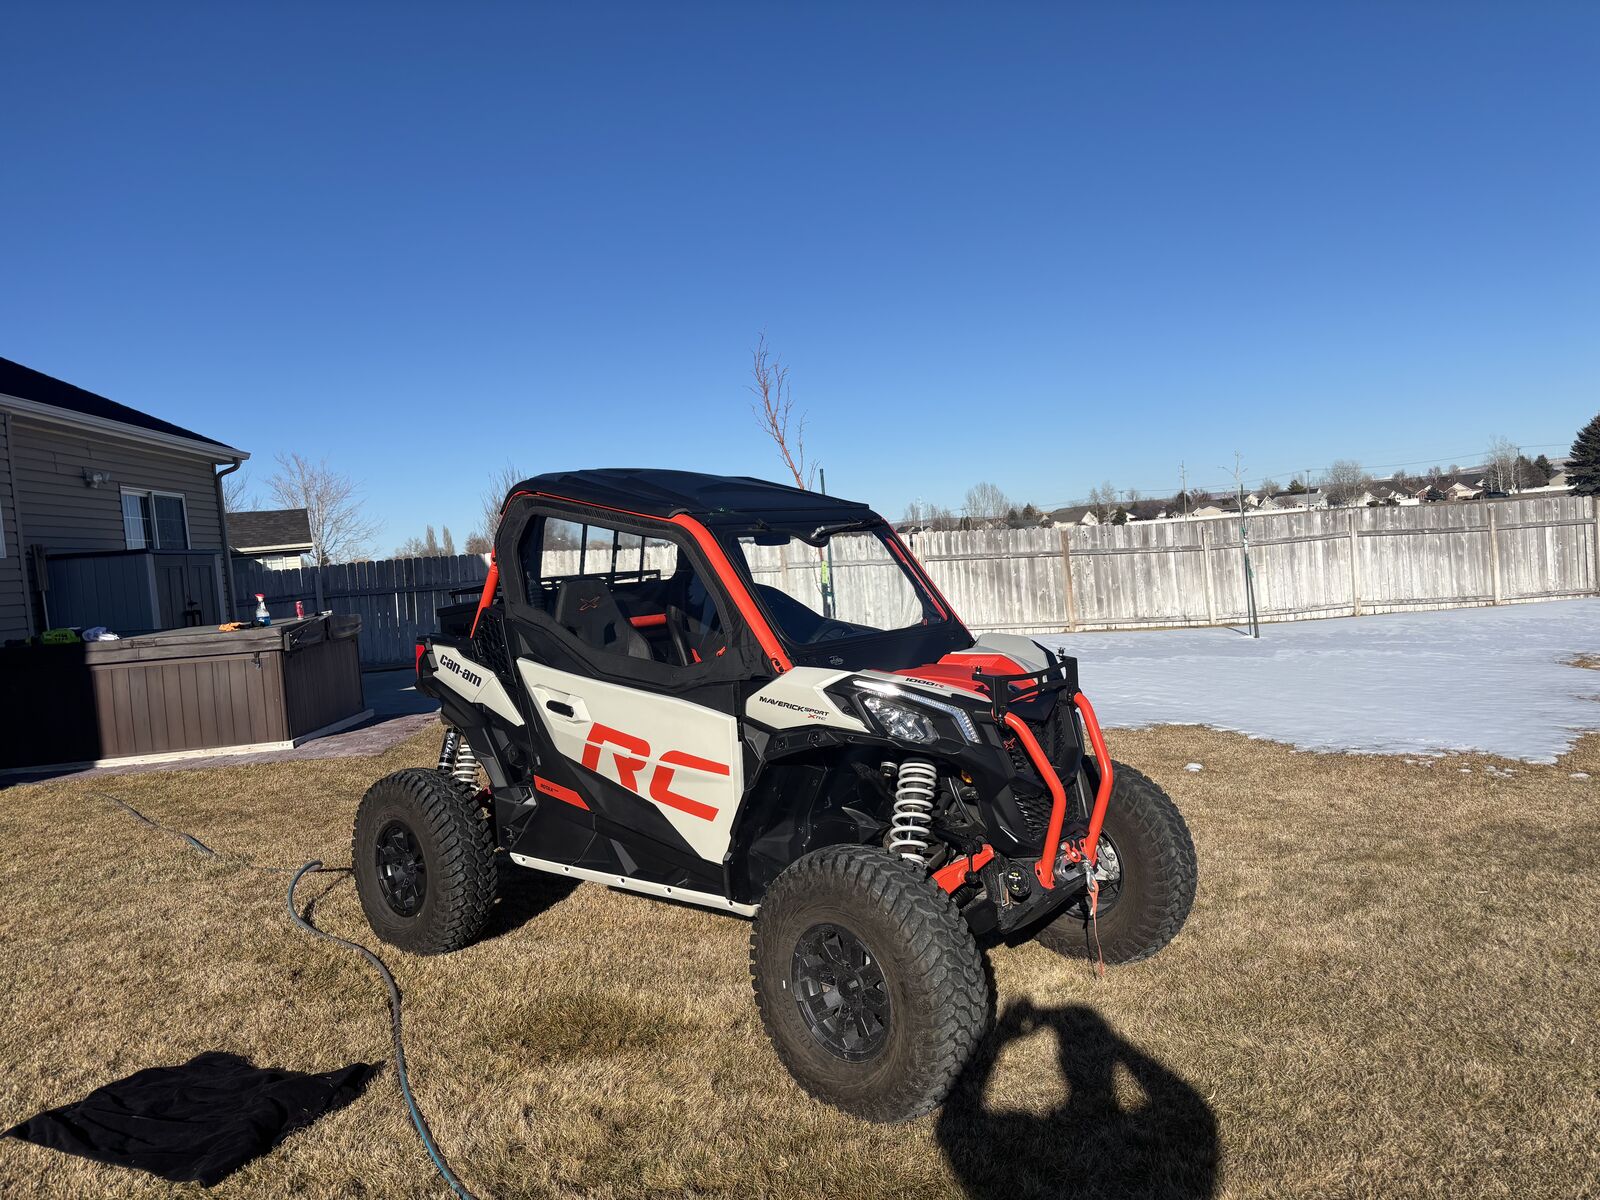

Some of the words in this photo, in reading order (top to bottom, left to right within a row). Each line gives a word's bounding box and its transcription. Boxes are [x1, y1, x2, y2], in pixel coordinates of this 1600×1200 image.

[440, 654, 482, 687] can-am
[759, 696, 804, 712] MAVERICK
[803, 707, 829, 716] SPORT
